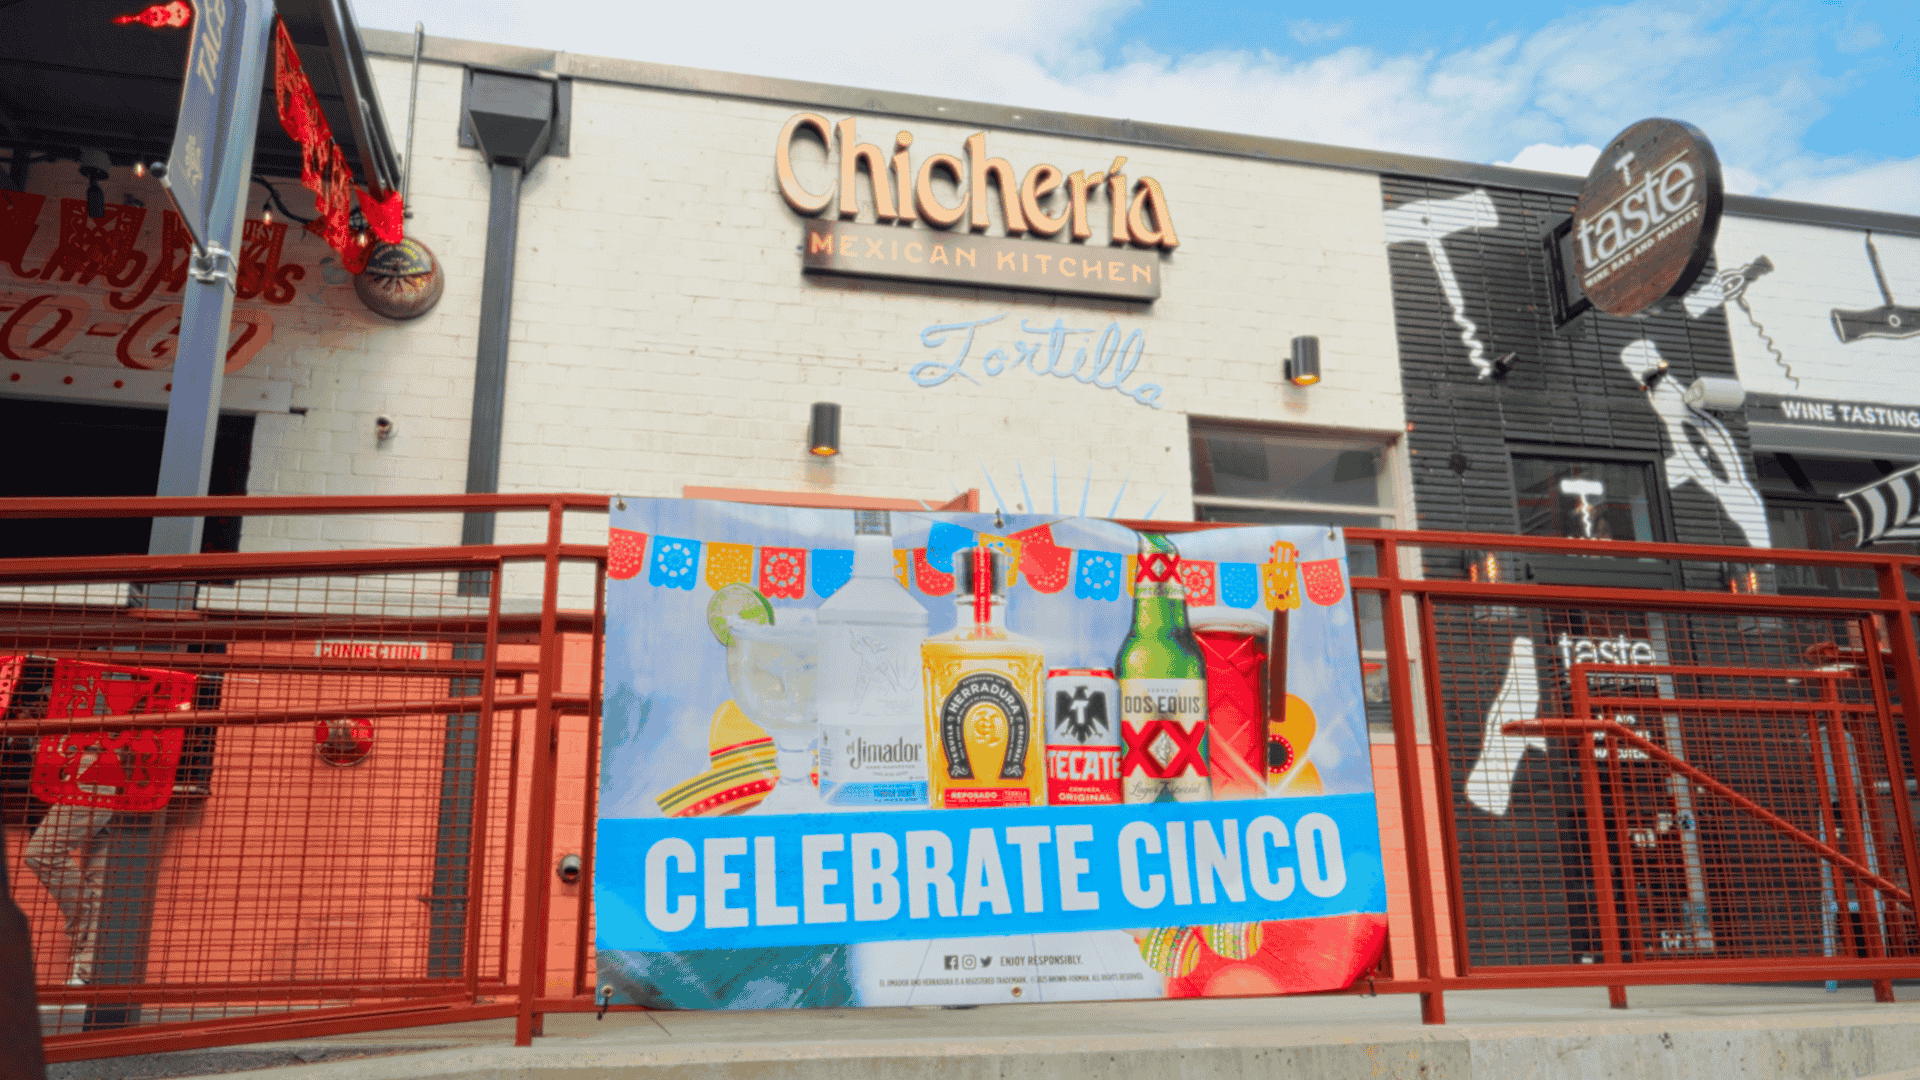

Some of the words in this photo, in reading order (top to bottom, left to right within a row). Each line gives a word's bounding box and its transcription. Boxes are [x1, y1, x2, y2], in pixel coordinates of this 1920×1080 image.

[776, 112, 1180, 250] Chichería
[1577, 161, 1695, 268] taste
[1611, 253, 1632, 270] BAR
[1634, 238, 1656, 256] AND
[1657, 207, 1701, 241] MARKET
[810, 232, 976, 268] MEXICAN
[997, 251, 1152, 283] KITCHEN
[909, 312, 1164, 409] Tortilla
[1781, 400, 1836, 421] WINE
[1838, 404, 1920, 428] TASTING
[321, 644, 421, 659] CONNECTION
[1559, 633, 1656, 668] taste
[947, 682, 1021, 715] HERRADURA
[1124, 696, 1153, 714] DOS
[1157, 696, 1200, 714] EQUIS
[850, 736, 922, 770] Jimador
[1047, 750, 1121, 781] TECATE
[1058, 792, 1112, 802] ORIGINAL
[645, 824, 1100, 932] CELEBRATE
[1117, 812, 1348, 909] CINCO
[1000, 956, 1025, 967] ENJOY
[1027, 954, 1083, 966] RESPONSIBLY.
